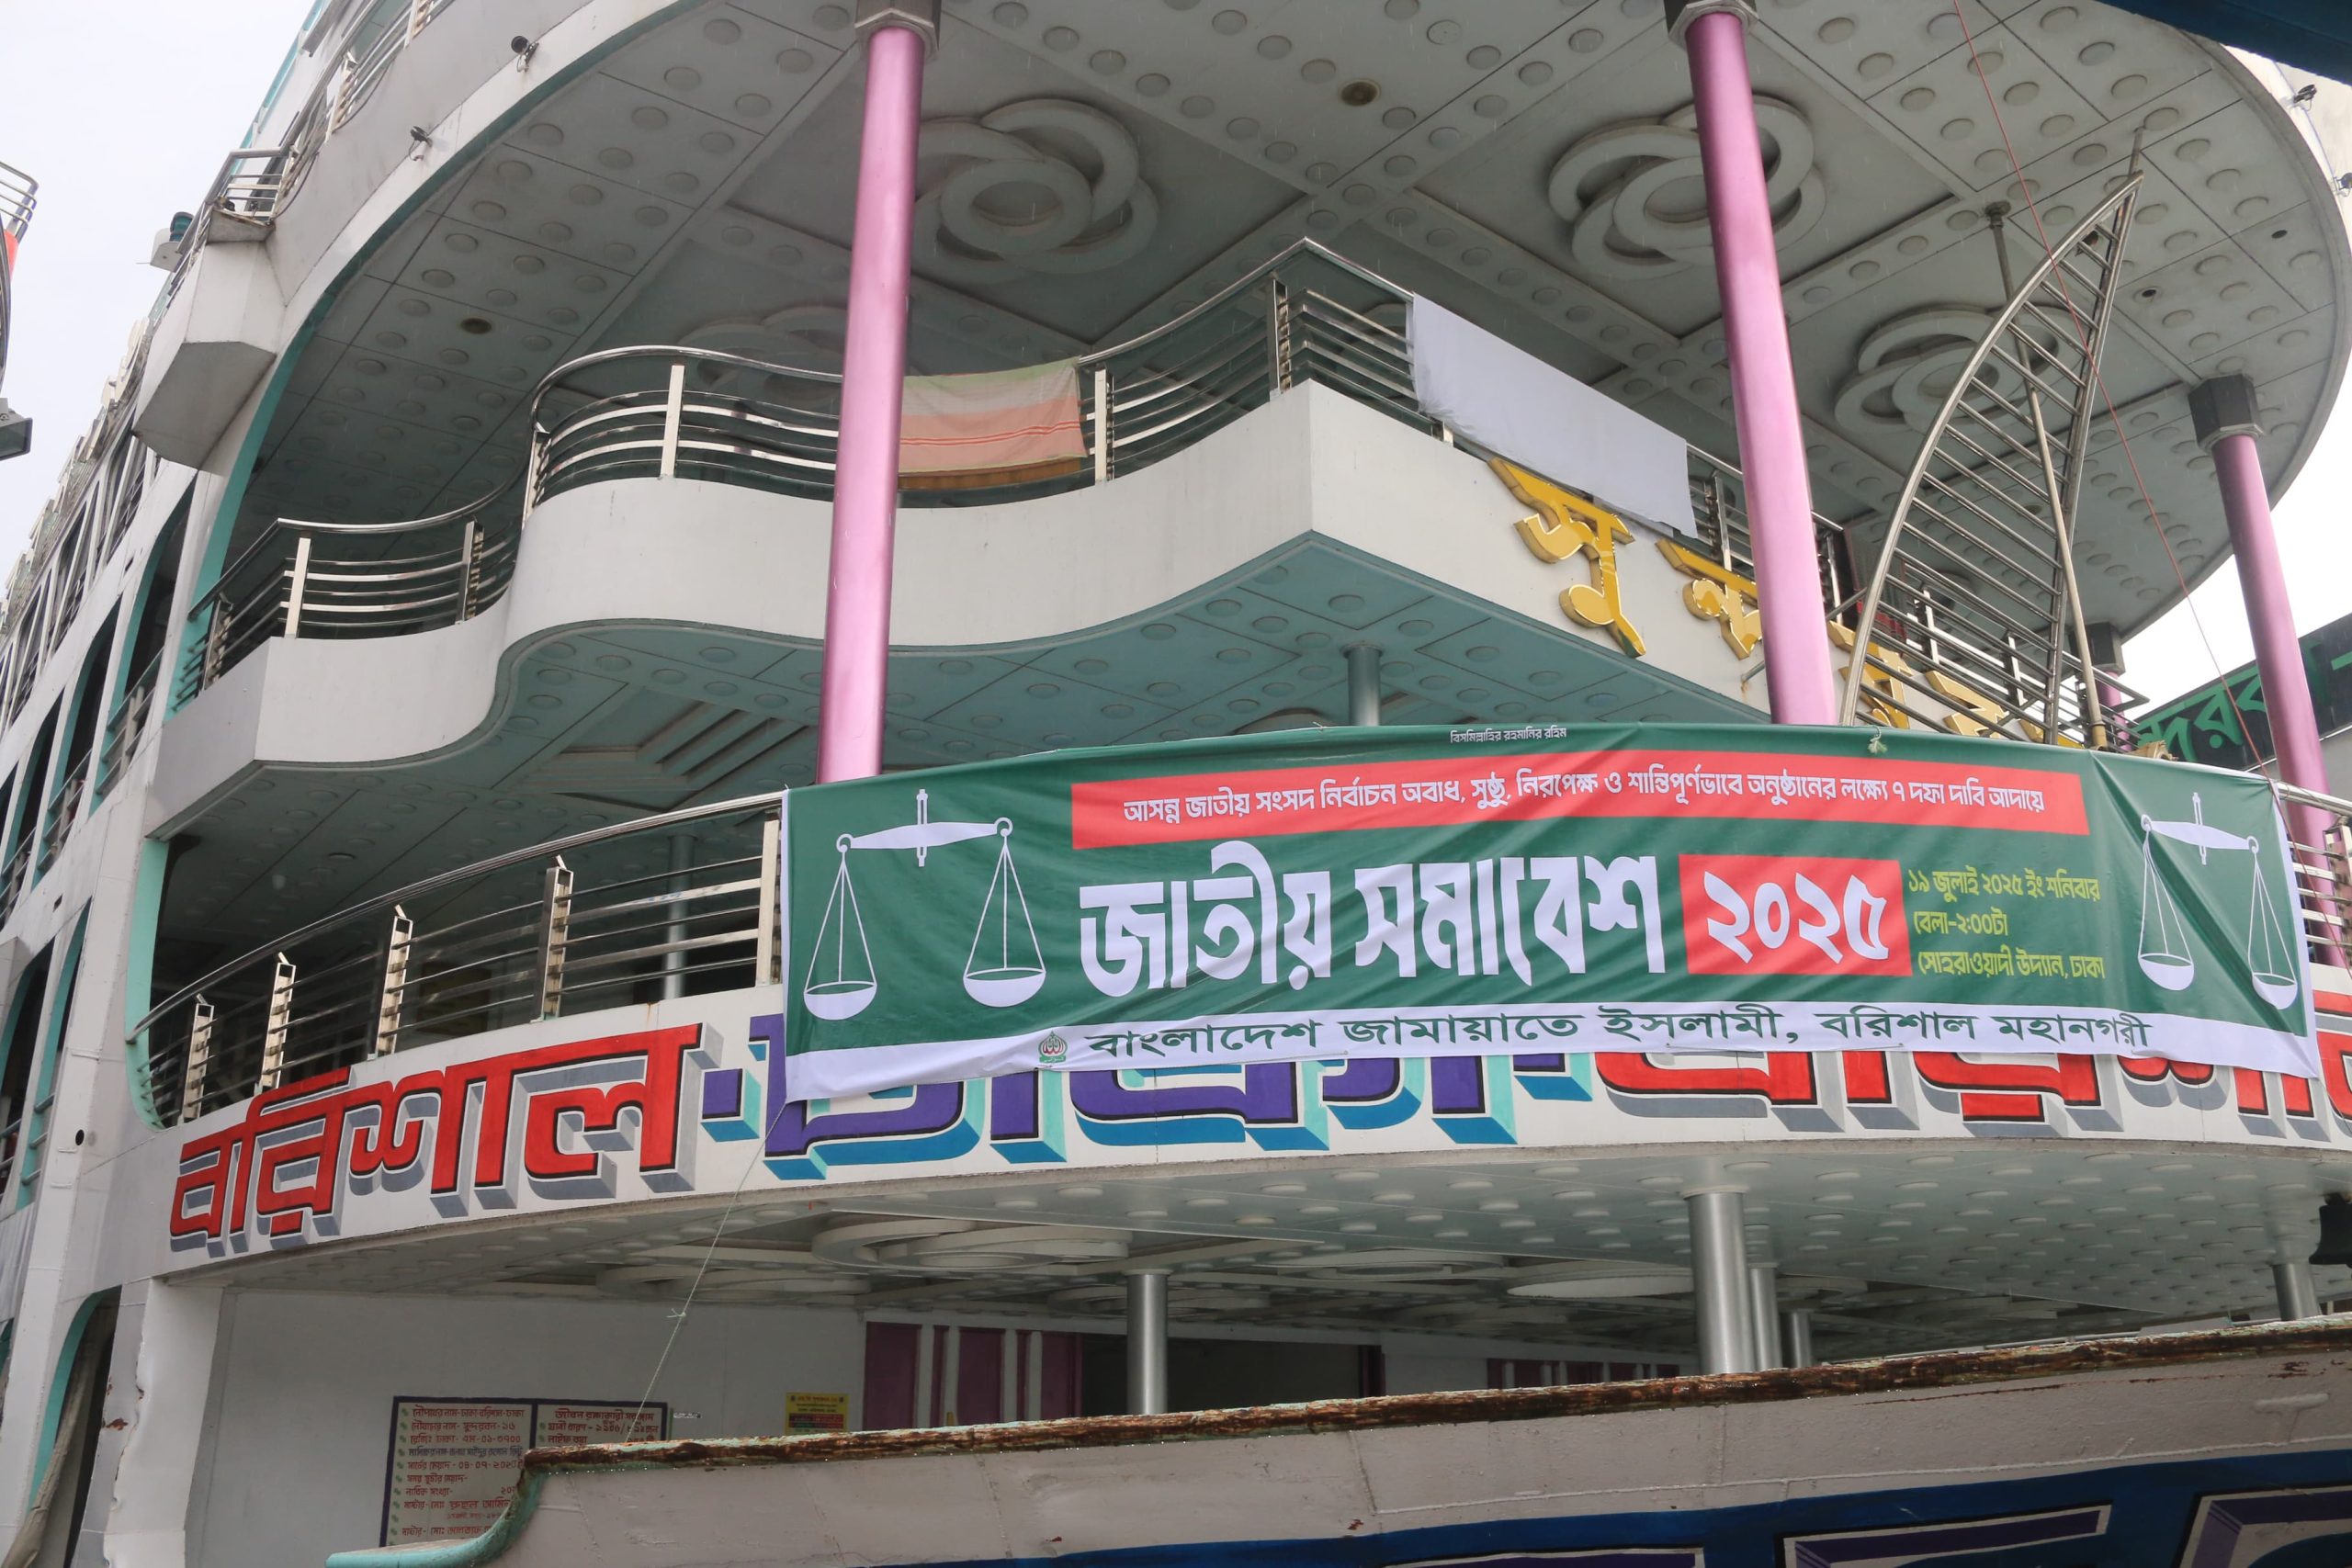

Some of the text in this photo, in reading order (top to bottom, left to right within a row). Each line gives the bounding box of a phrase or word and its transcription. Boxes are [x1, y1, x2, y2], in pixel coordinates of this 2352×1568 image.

[1450, 725, 1566, 743] বিসমিল্লাহির রহমানির রহিম
[1123, 762, 2044, 824] আসন্ন জাতীয় সংসদ নির্বাচন অবাধ, সুষ্ঠু, নিরপেক্ষ ও শান্তিপূর্ণভাবে অনুষ্ঠানের লক্ষ্যে ৭ দফা দাবি আদায়ে
[1908, 864, 2101, 903] ১৯ জুলাই ২০২৫ ইং শনিবার
[1080, 840, 1889, 997] জাতীয় সমাবেশ ২০২৫
[2016, 947, 2069, 979] উদ্যান,
[2069, 955, 2107, 979] ঢাকা
[1085, 1018, 1326, 1059] বাংলাদেশ
[1339, 1011, 1587, 1050] জামায়াতে
[1598, 1003, 1799, 1045] ইসলামী,
[1815, 1005, 1980, 1040] বরিশাল
[1992, 1010, 2153, 1047] মহানগরী
